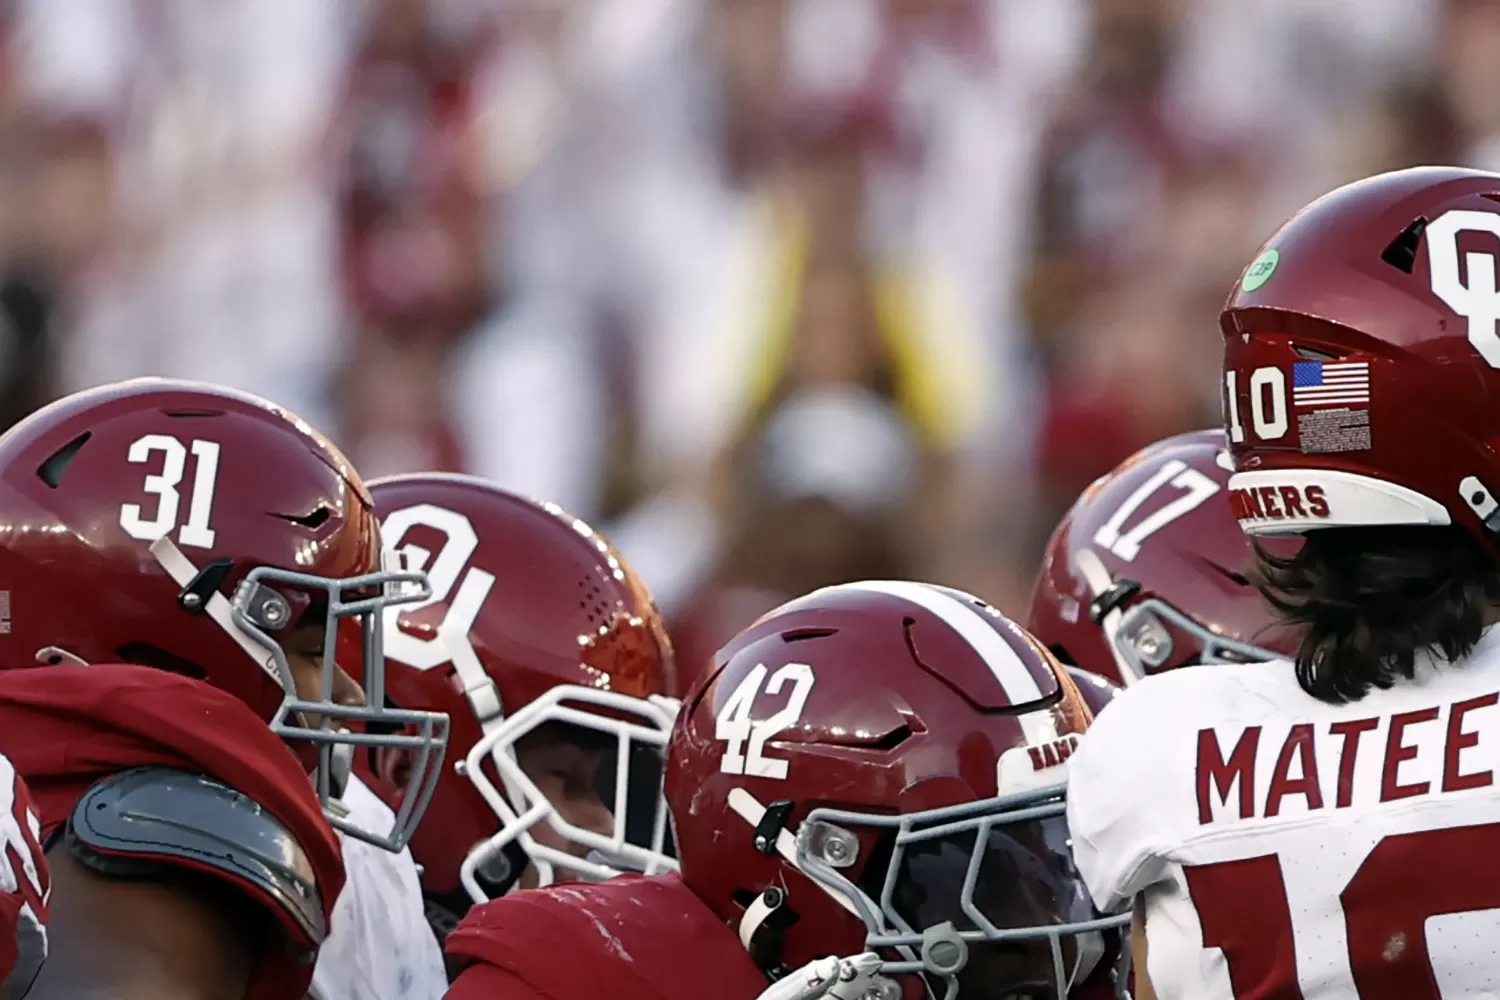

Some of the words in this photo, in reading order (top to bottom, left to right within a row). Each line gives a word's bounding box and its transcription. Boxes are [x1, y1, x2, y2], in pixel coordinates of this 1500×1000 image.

[1226, 366, 1289, 444] 10
[119, 434, 222, 550] 31
[1093, 459, 1221, 563] 17
[714, 661, 816, 780] 42
